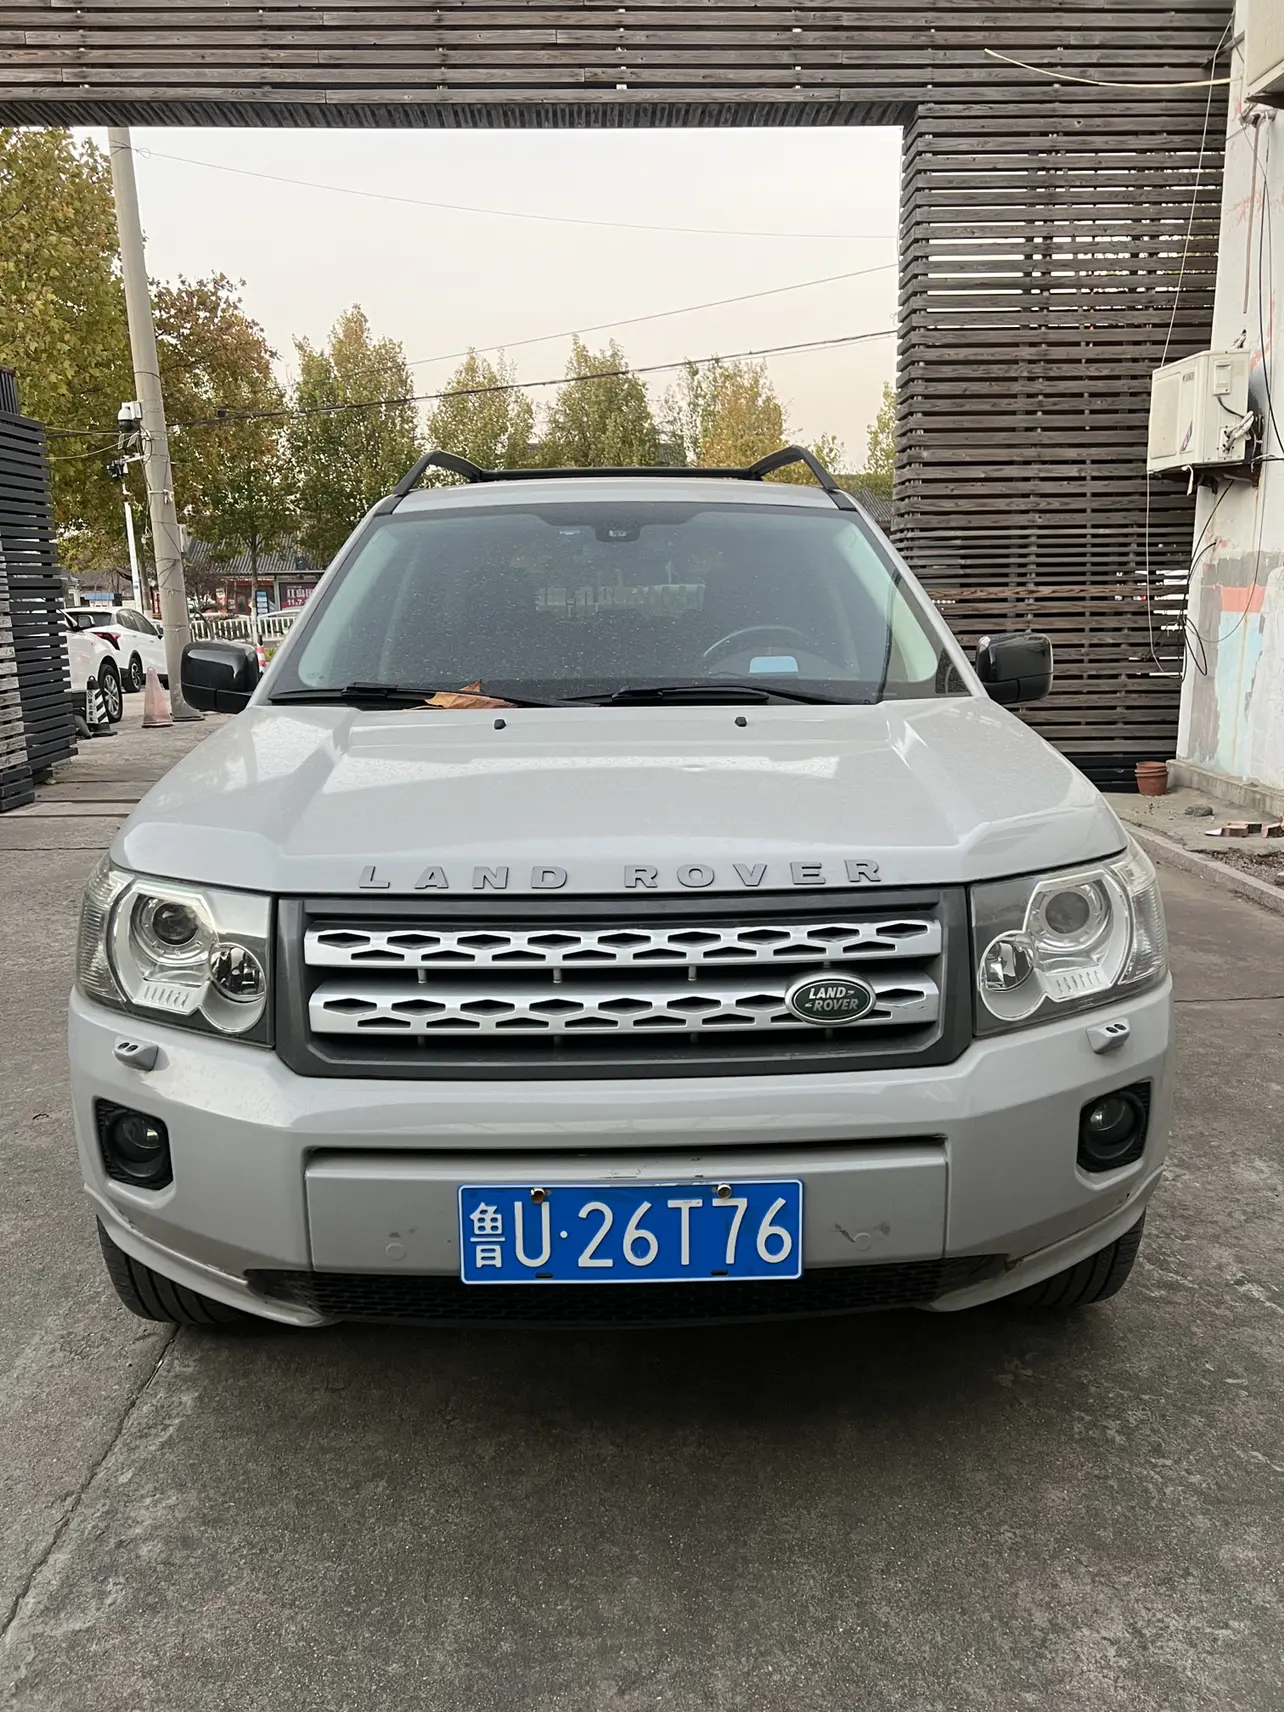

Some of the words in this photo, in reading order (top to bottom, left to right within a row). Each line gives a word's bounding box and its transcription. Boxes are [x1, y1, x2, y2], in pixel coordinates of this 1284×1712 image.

[359, 864, 568, 890] LAND
[624, 858, 883, 888] ROVER
[809, 987, 847, 999] LAND
[813, 998, 859, 1012] ROVER
